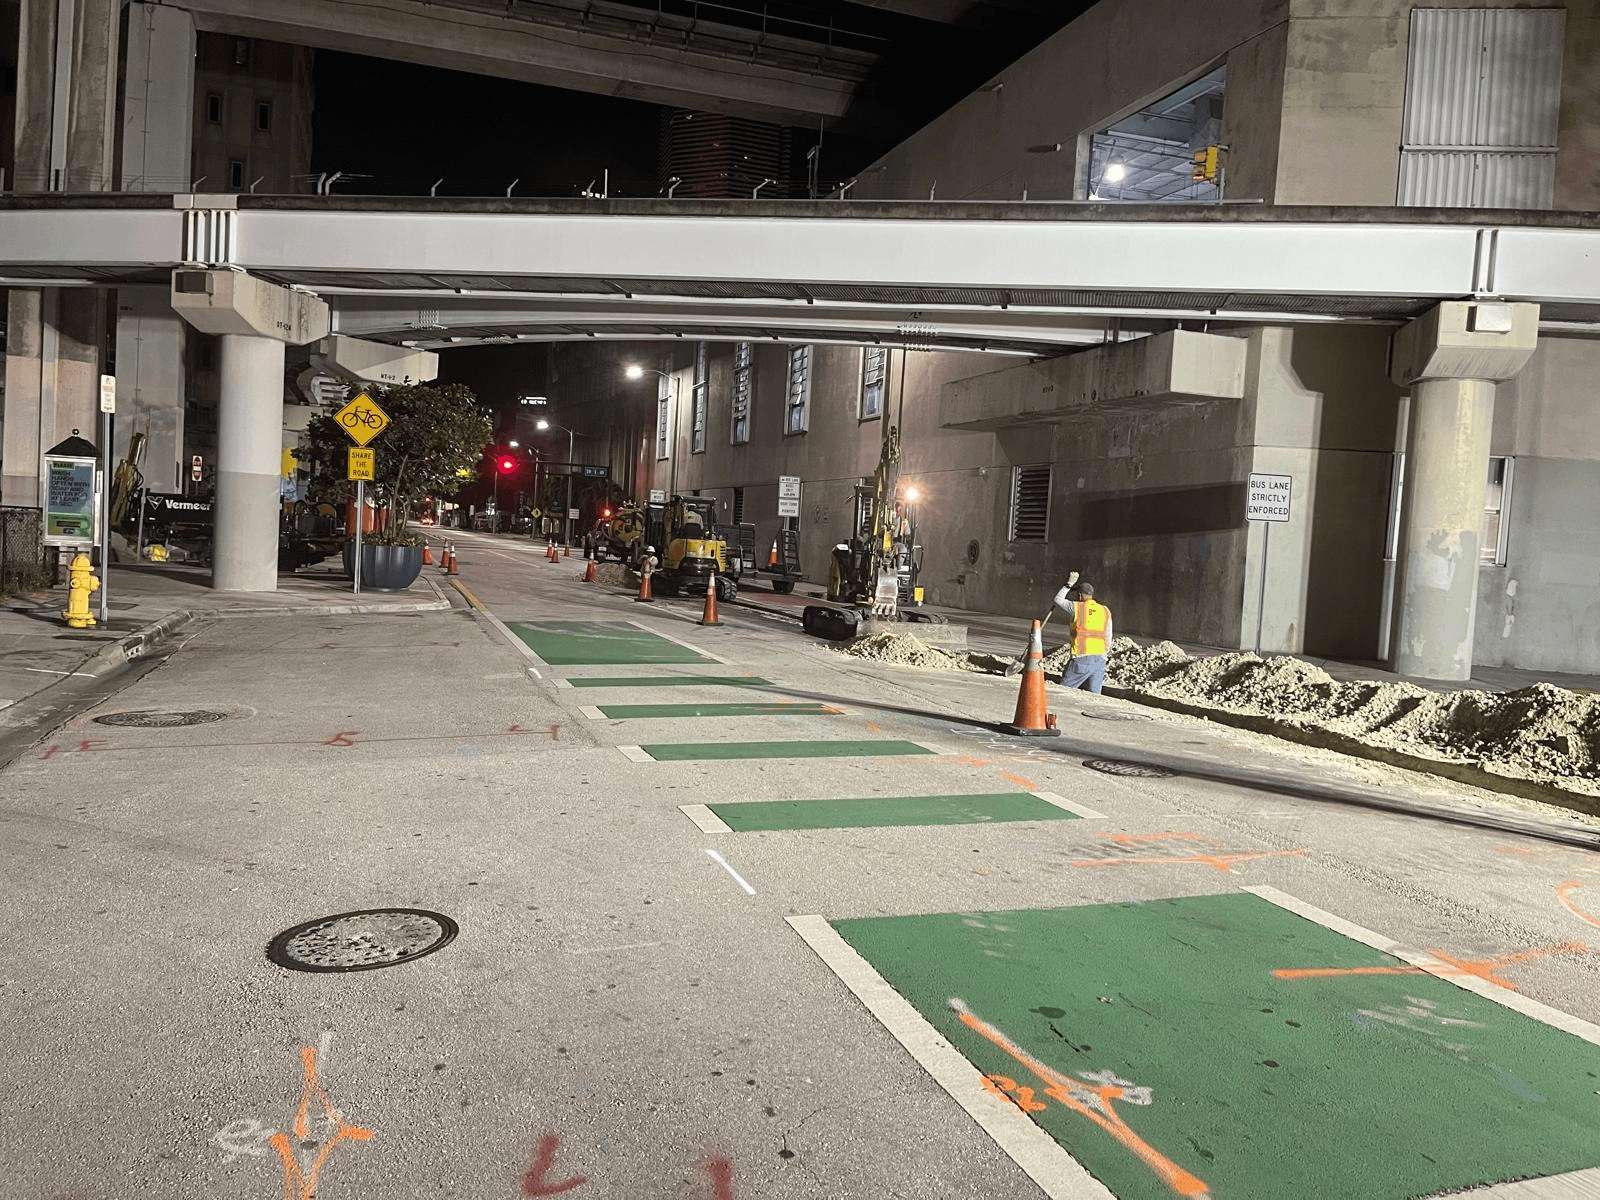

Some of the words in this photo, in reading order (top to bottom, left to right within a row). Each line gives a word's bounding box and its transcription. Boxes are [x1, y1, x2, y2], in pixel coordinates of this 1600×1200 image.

[351, 452, 372, 460] SHARE
[352, 469, 370, 477] ROAD
[1250, 480, 1266, 489] BUS
[1268, 481, 1289, 490] LANE
[1251, 493, 1287, 503] STRICTLY
[165, 499, 212, 511] Vermeer
[1248, 505, 1289, 515] ENFORCED
